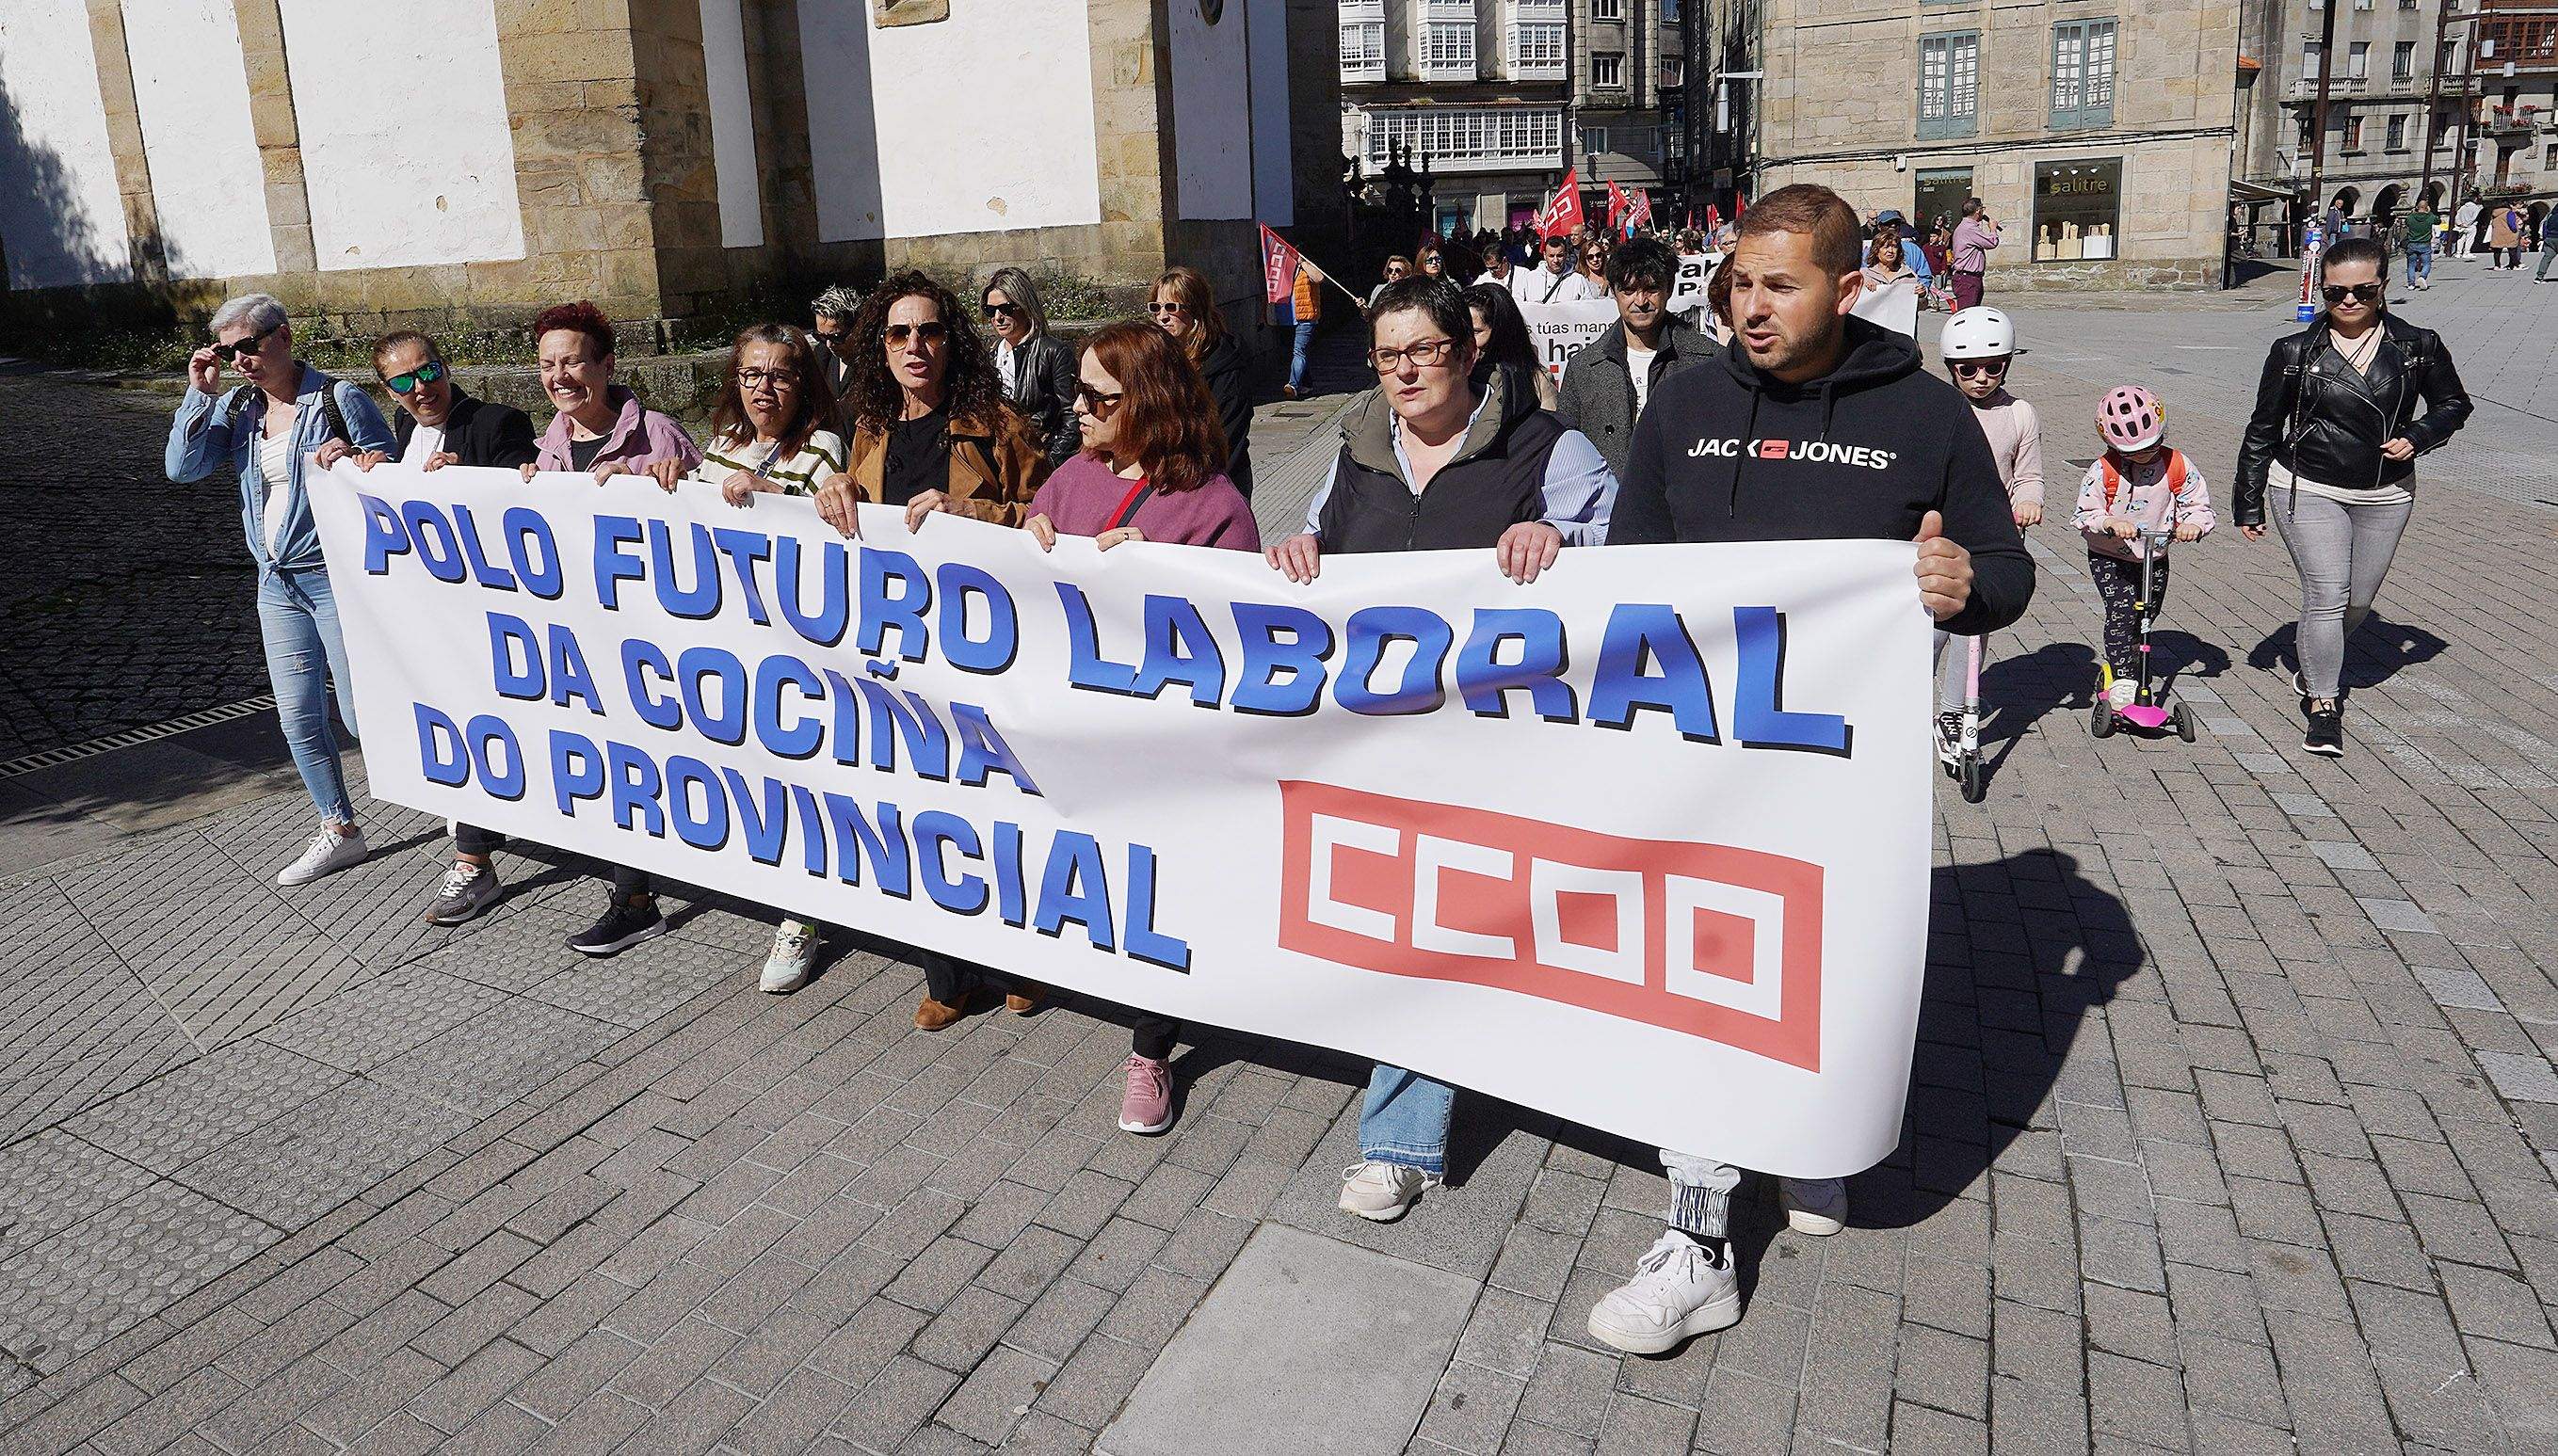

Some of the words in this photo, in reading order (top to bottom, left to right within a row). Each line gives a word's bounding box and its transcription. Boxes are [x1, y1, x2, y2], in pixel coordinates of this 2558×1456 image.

[2049, 175, 2108, 195] salitre
[1536, 322, 1569, 334] túas
[357, 492, 563, 601] POLO
[593, 514, 1019, 676] FUTURO
[1054, 581, 1852, 758] LABORAL
[487, 612, 607, 716] DA
[620, 637, 1044, 798] COCIÑA
[413, 702, 526, 802] DO
[549, 729, 1192, 975] PROVINCIAL
[1306, 811, 1785, 1023] CCOO
